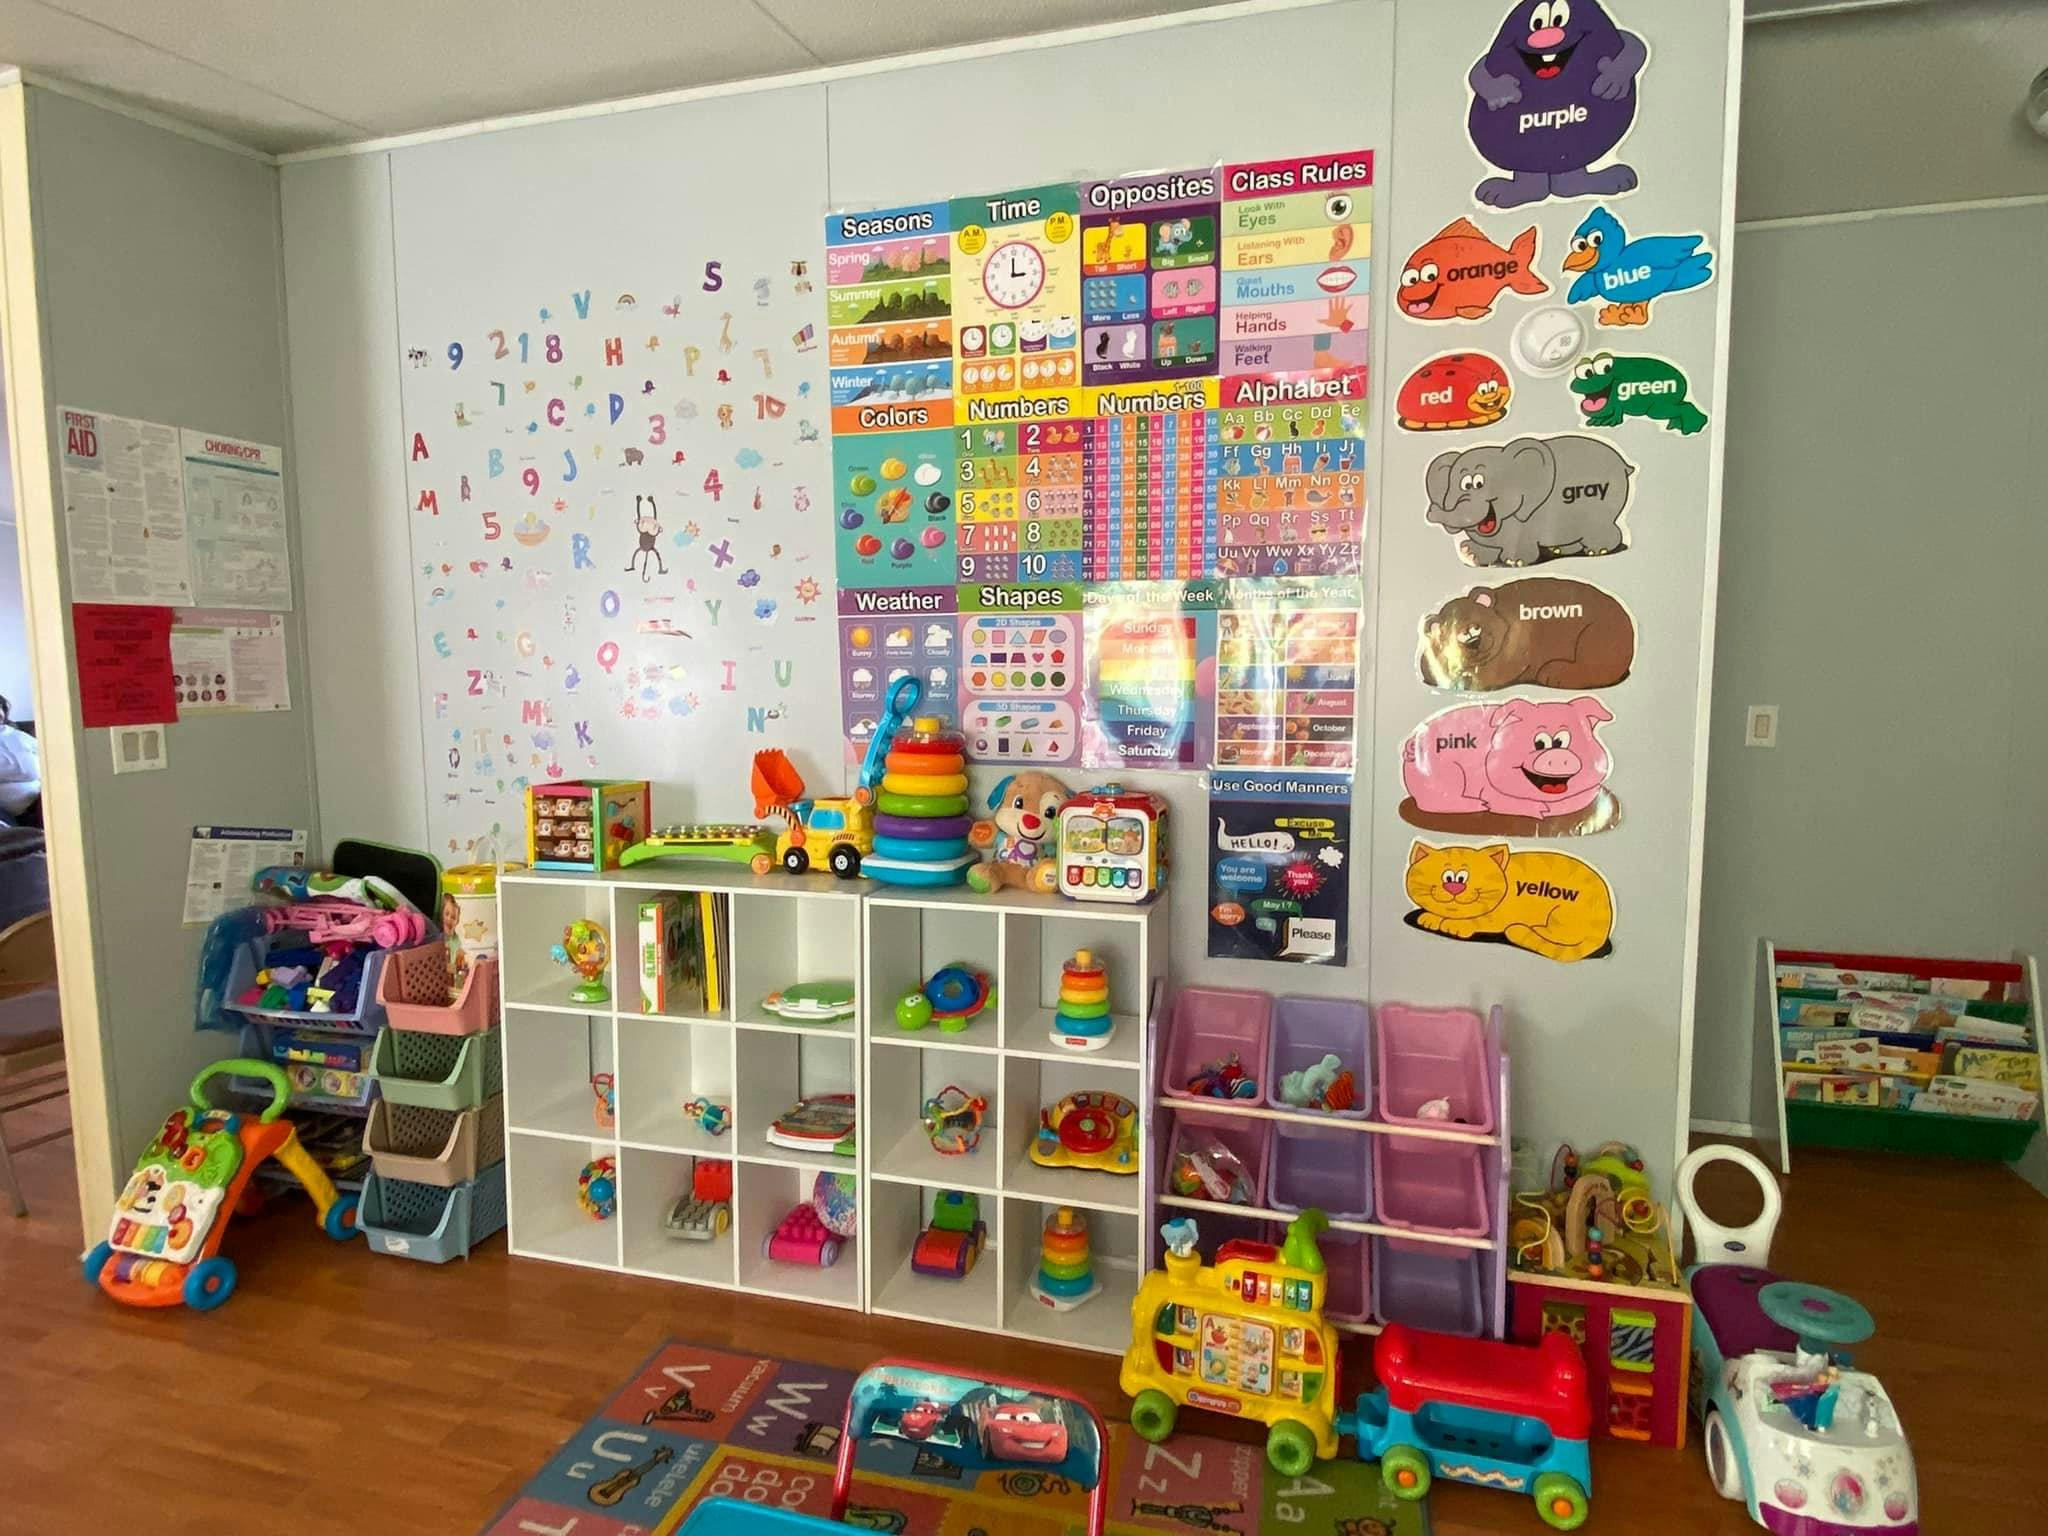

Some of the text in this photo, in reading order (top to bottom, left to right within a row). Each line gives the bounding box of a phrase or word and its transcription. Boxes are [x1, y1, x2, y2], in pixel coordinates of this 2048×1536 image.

[1518, 104, 1587, 133] purple
[1231, 162, 1367, 193] Class Rules
[1090, 177, 1215, 210] Opposites
[986, 198, 1041, 222] Time
[1238, 200, 1285, 214] Look With
[842, 213, 933, 238] Seasons
[1239, 213, 1277, 230] Eyes
[1237, 235, 1305, 251] Listening With
[828, 252, 870, 267] Spring
[1237, 253, 1274, 266] Ears
[702, 260, 723, 292] S
[1446, 258, 1518, 284] orange
[1602, 263, 1652, 291] blue
[829, 287, 881, 302] Summer
[1236, 283, 1295, 299] Mouths
[571, 289, 591, 319] V
[1235, 310, 1272, 322] Helping
[1236, 318, 1287, 334] Hands
[831, 331, 880, 346] Autumn
[1234, 342, 1272, 353] Walking
[447, 342, 463, 370] 9
[546, 334, 563, 364] 8
[604, 336, 624, 367] H
[1235, 351, 1270, 366] Feet
[831, 374, 873, 388] Winter
[1235, 377, 1353, 405] Alphabet
[1617, 377, 1677, 401] green
[1098, 391, 1206, 416] Numbers
[1420, 386, 1453, 405] red
[546, 398, 566, 427] C
[608, 393, 625, 425] D
[860, 407, 929, 428] Colors
[969, 397, 1069, 421] Numbers
[1224, 405, 1360, 424] Aa Bb Cc Dd Ee
[64, 411, 97, 429] FIRST
[647, 414, 667, 445] 3
[67, 427, 98, 458] AID
[961, 428, 972, 450] 1
[1027, 425, 1040, 446] 2
[412, 432, 429, 461] A
[1224, 446, 1240, 457] Ff
[1251, 445, 1271, 459] Gg
[1282, 443, 1301, 454] Hh
[961, 461, 974, 481] 3
[1026, 457, 1041, 477] 4
[703, 468, 723, 501] 4
[1223, 480, 1240, 490] Kk
[1276, 478, 1301, 488] Mm
[1311, 476, 1331, 486] Nn
[1339, 474, 1360, 485] Oo
[1561, 479, 1609, 503] gray
[416, 490, 440, 515] M
[961, 492, 975, 514] 5
[1026, 490, 1041, 512] 6
[482, 512, 501, 540] 5
[1223, 510, 1354, 527] Pp Qq Rr Ss Tt
[962, 524, 976, 546] 7
[1027, 522, 1041, 542] 8
[572, 533, 595, 569] R
[708, 539, 734, 569] X
[1266, 546, 1292, 556] Ww
[1297, 545, 1314, 555] Xx
[1320, 545, 1336, 557] Yy
[961, 557, 975, 577] 9
[1022, 554, 1047, 575] 10
[855, 591, 943, 612] Weather
[979, 586, 1064, 609] Shapes
[1172, 588, 1214, 603] Week
[1321, 586, 1352, 599] Year
[1518, 602, 1583, 621] brown
[1010, 618, 1041, 627] Shapes
[1123, 621, 1173, 635] Sunday
[597, 641, 619, 674] Q
[466, 669, 484, 696] Z
[1109, 683, 1184, 698] Wednesday
[1117, 704, 1177, 718] Thursday
[1317, 698, 1346, 709] August
[747, 707, 766, 733] N
[1312, 723, 1346, 732] October
[574, 720, 594, 749] K
[1127, 724, 1167, 738] Friday
[1118, 744, 1176, 759] Saturday
[1435, 732, 1478, 752] pink
[1212, 779, 1348, 794] Use Good Manners
[1230, 839, 1278, 850] HELLO!
[1220, 864, 1238, 873] You
[1220, 873, 1263, 883] welcome
[1287, 870, 1313, 879] Thank
[1292, 878, 1309, 886] you
[1514, 878, 1579, 903] yellow
[1262, 901, 1280, 910] May
[1220, 913, 1242, 921] sorry
[1291, 927, 1332, 941] Please
[721, 1358, 771, 1414] vacuum
